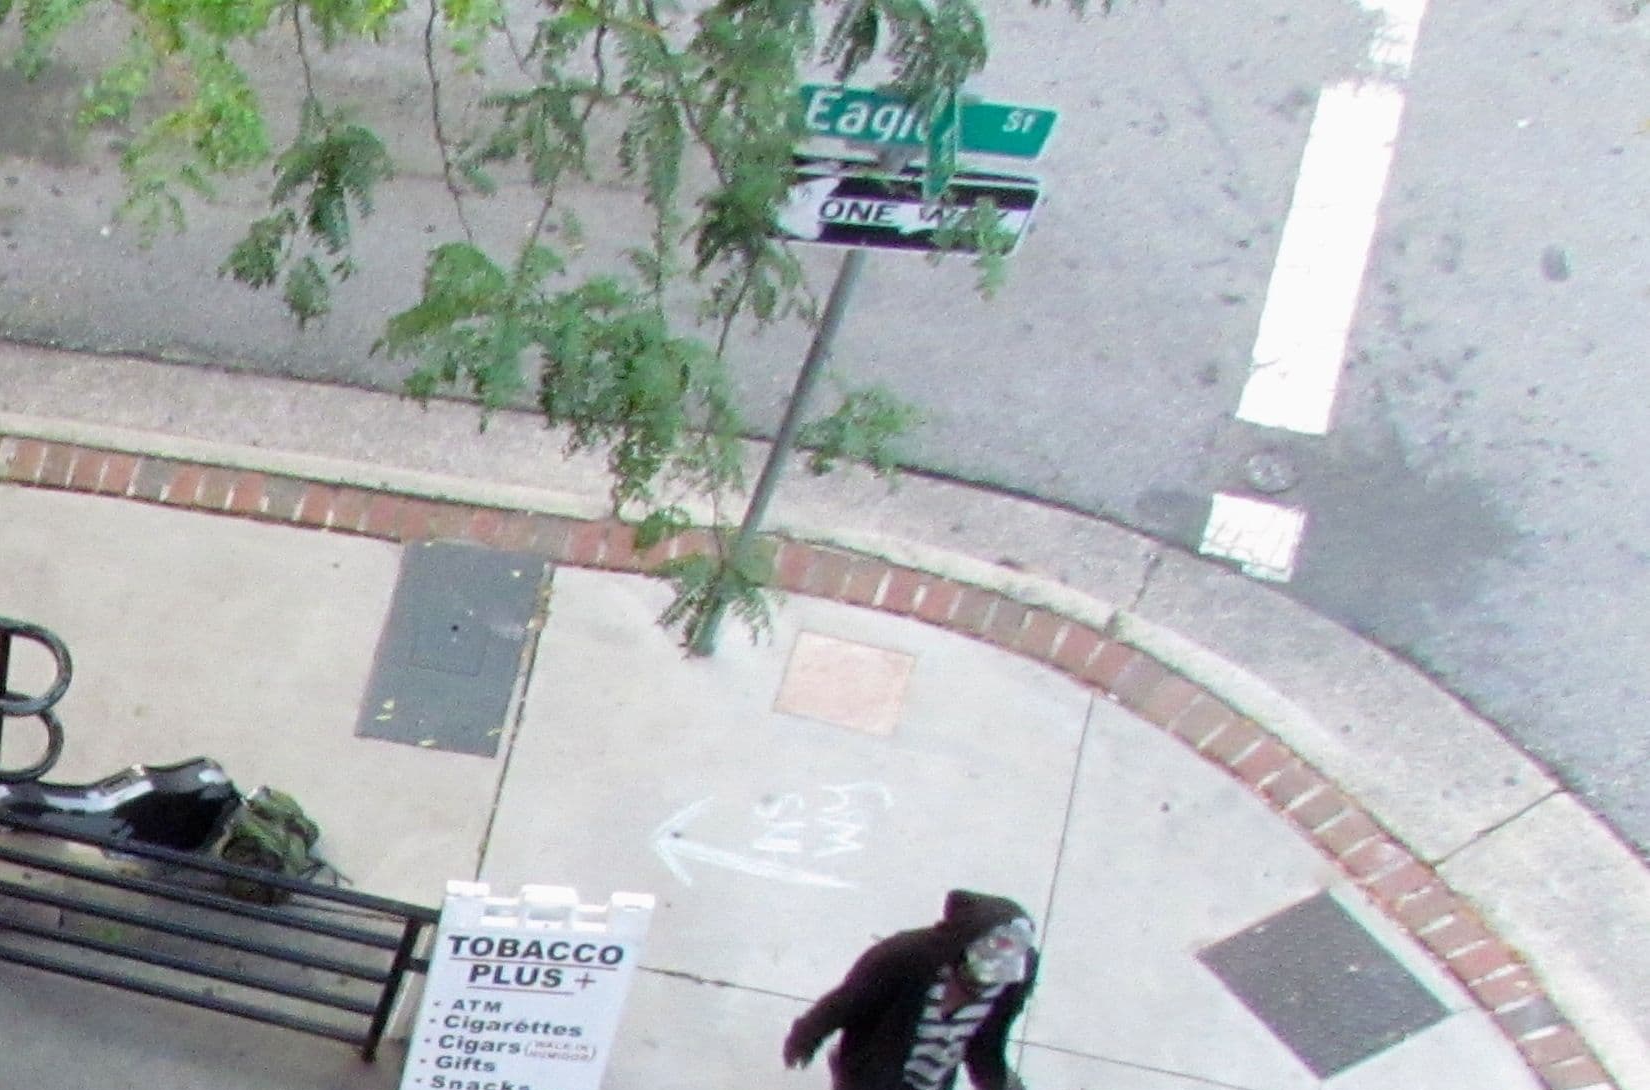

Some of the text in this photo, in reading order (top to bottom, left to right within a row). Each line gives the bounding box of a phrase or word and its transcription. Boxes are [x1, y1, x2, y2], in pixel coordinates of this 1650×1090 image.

[818, 199, 898, 223] ONE
[448, 935, 624, 965] TOBACCO
[468, 963, 564, 989] PLUS
[451, 999, 503, 1013] ATM
[437, 1034, 522, 1054] Cigars
[434, 1055, 497, 1073] Gifts
